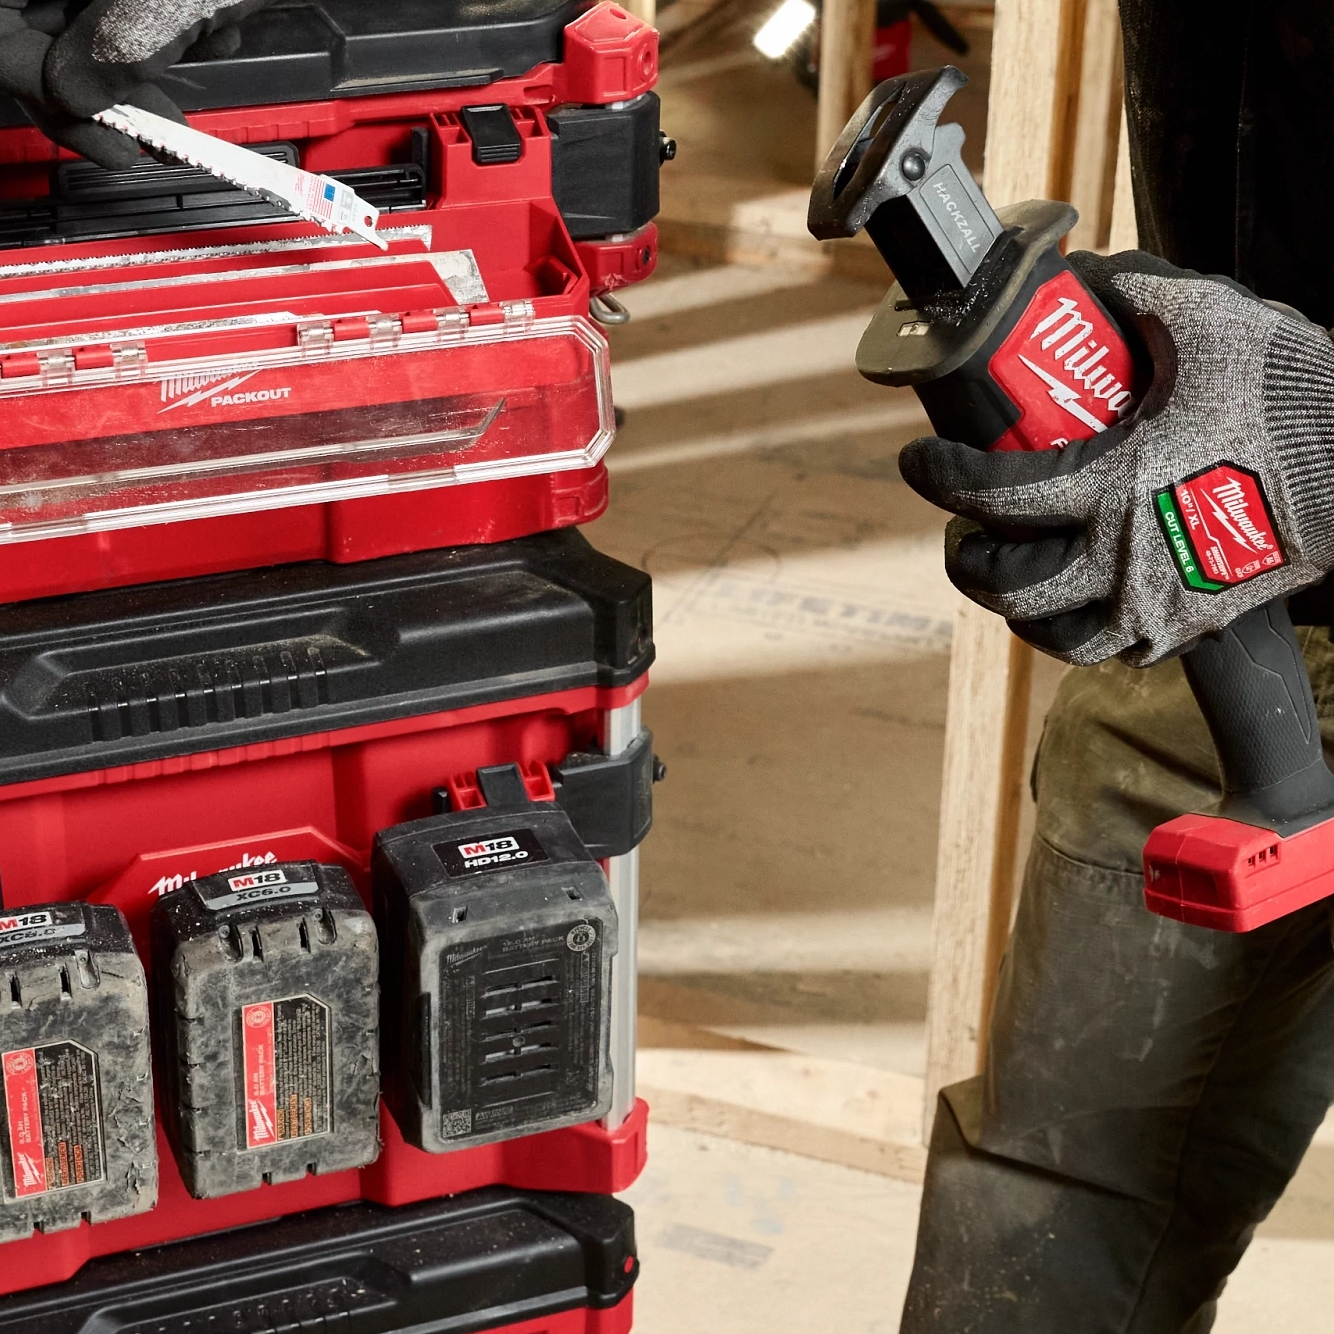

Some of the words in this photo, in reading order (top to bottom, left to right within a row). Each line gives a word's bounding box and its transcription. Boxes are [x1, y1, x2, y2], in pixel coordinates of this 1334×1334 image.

[933, 182, 980, 254] HACKZALL
[1030, 297, 1132, 417] Milwa
[210, 387, 292, 408] PACKOUT
[1188, 514, 1200, 530] XL
[1165, 511, 1179, 533] CUT
[1172, 533, 1191, 565] LEVEL
[1185, 565, 1195, 573] 6
[464, 840, 513, 855] M18
[464, 851, 528, 868] HD12.0
[233, 873, 281, 888] M18
[236, 886, 291, 901] XC6.0
[21, 1091, 29, 1110] PACK
[23, 1110, 32, 1144] BATTERY
